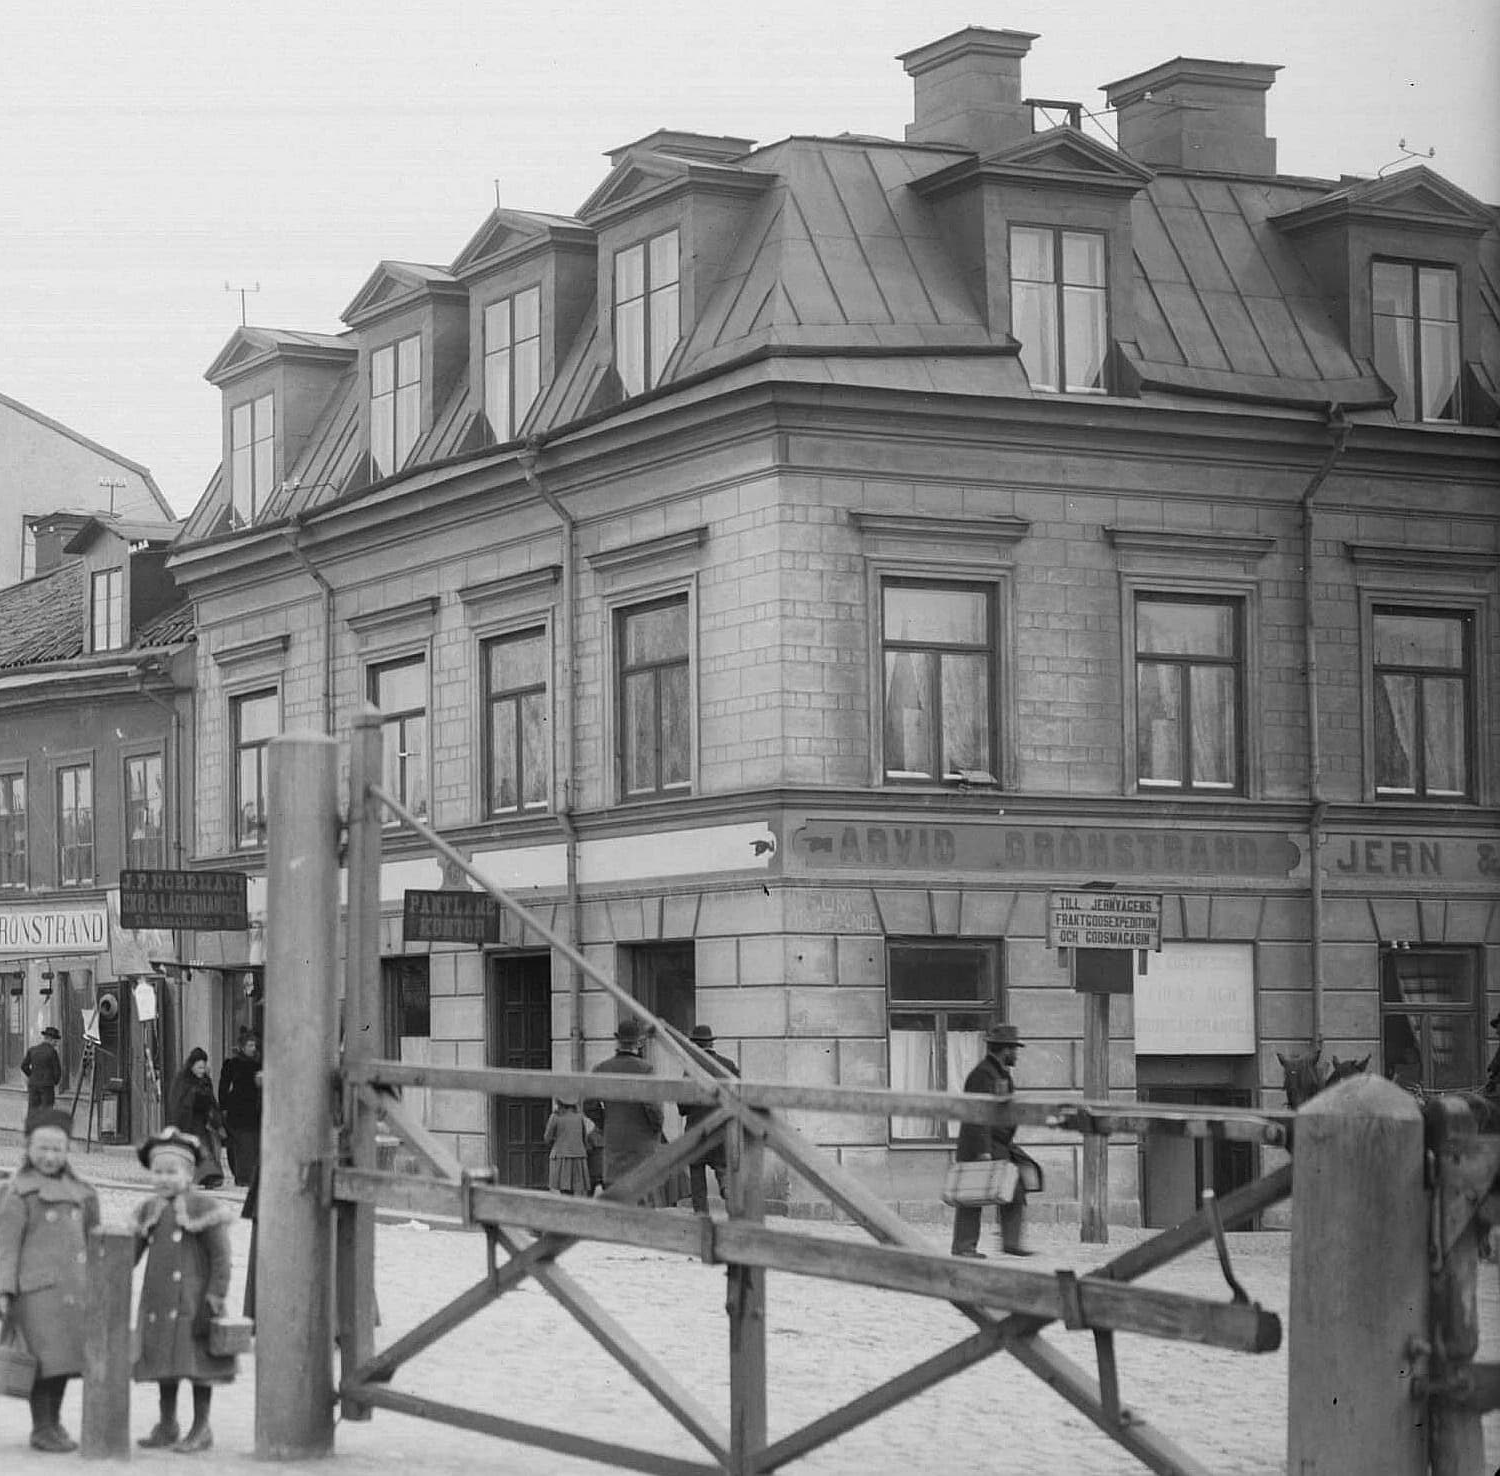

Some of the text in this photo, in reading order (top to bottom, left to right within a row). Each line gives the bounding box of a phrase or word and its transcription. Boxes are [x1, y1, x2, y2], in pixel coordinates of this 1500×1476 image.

[839, 826, 956, 866] ARVID
[1336, 840, 1500, 877] JERN &
[147, 893, 158, 913] &
[1060, 897, 1081, 910] TILL
[1060, 930, 1151, 945] OCH GODSMAGASIN
